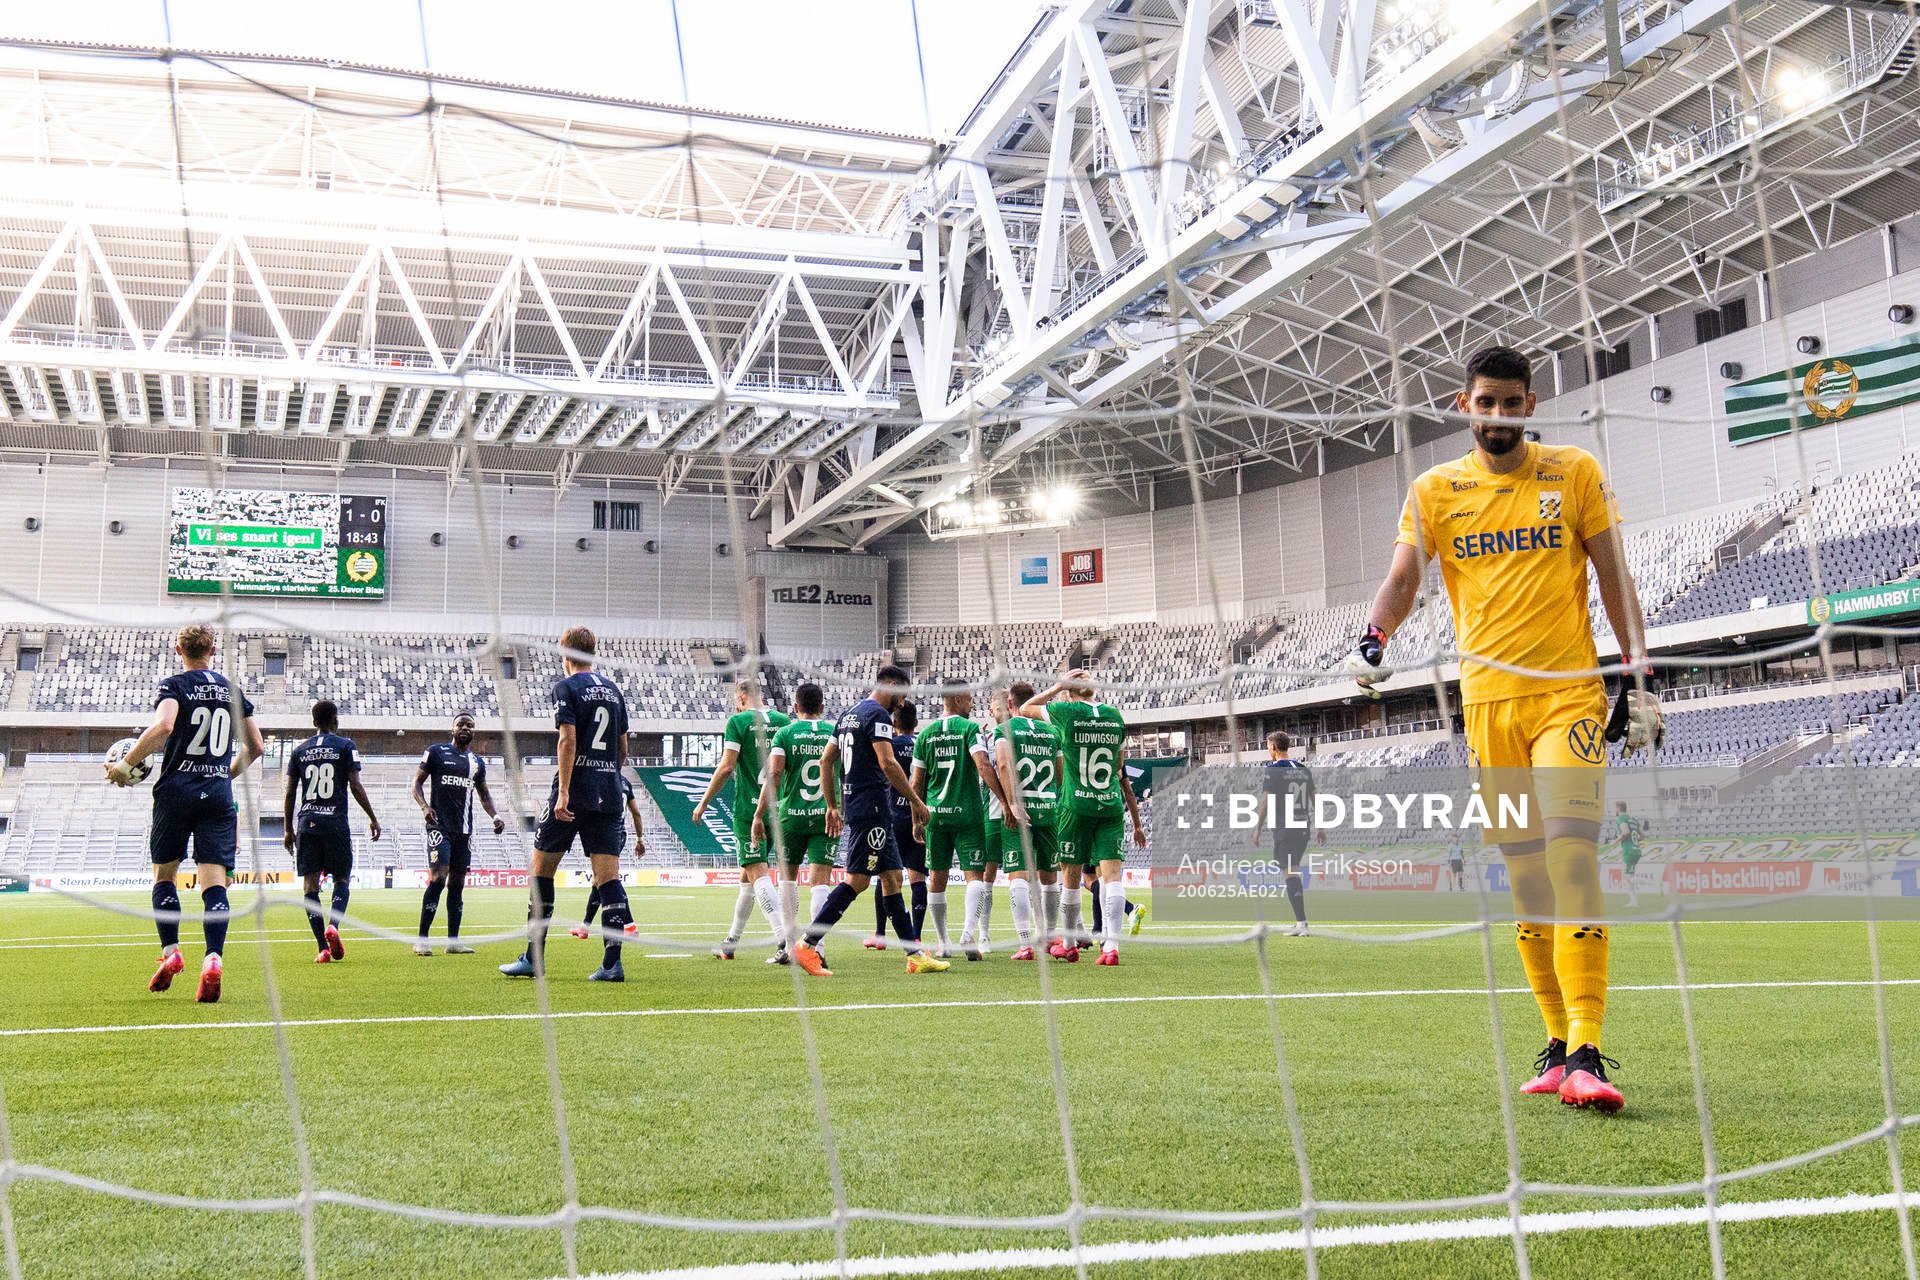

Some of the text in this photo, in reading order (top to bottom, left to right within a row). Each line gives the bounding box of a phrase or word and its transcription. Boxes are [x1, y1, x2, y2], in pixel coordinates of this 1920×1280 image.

[1536, 472, 1564, 481] RASTA
[1451, 480, 1478, 492] RASTA
[346, 508, 353, 522] 1
[371, 509, 381, 523] 0
[1450, 511, 1474, 519] CRAFT
[195, 528, 212, 541] Vi
[242, 529, 278, 543] snart
[282, 530, 316, 547] igen!
[346, 531, 379, 544] 18:43
[1453, 525, 1563, 560] SERNEKE
[1070, 554, 1092, 572] JOB
[1069, 571, 1095, 583] ZONE
[772, 584, 872, 605] TELE2 Arena
[1834, 588, 1910, 615] HAMMARBY
[186, 706, 231, 758] 20
[591, 706, 610, 751] 2
[1074, 731, 1120, 745] LUDWIGSON
[305, 747, 334, 755] NORDIC
[791, 744, 824, 756] P.GUERR
[300, 753, 340, 762] WELLNESS
[1078, 746, 1114, 790] 16
[304, 762, 335, 801] 28
[800, 758, 825, 801] 9
[937, 760, 956, 800] 7
[1015, 756, 1057, 799] 22
[1569, 799, 1595, 808] CRAFT
[808, 808, 826, 816] LINE
[59, 877, 153, 888] Stena Fastigheter
[1674, 864, 1801, 894] Heja backlinjen!
[1843, 872, 1882, 881] SVENA
[1843, 882, 1864, 891] SPEL
